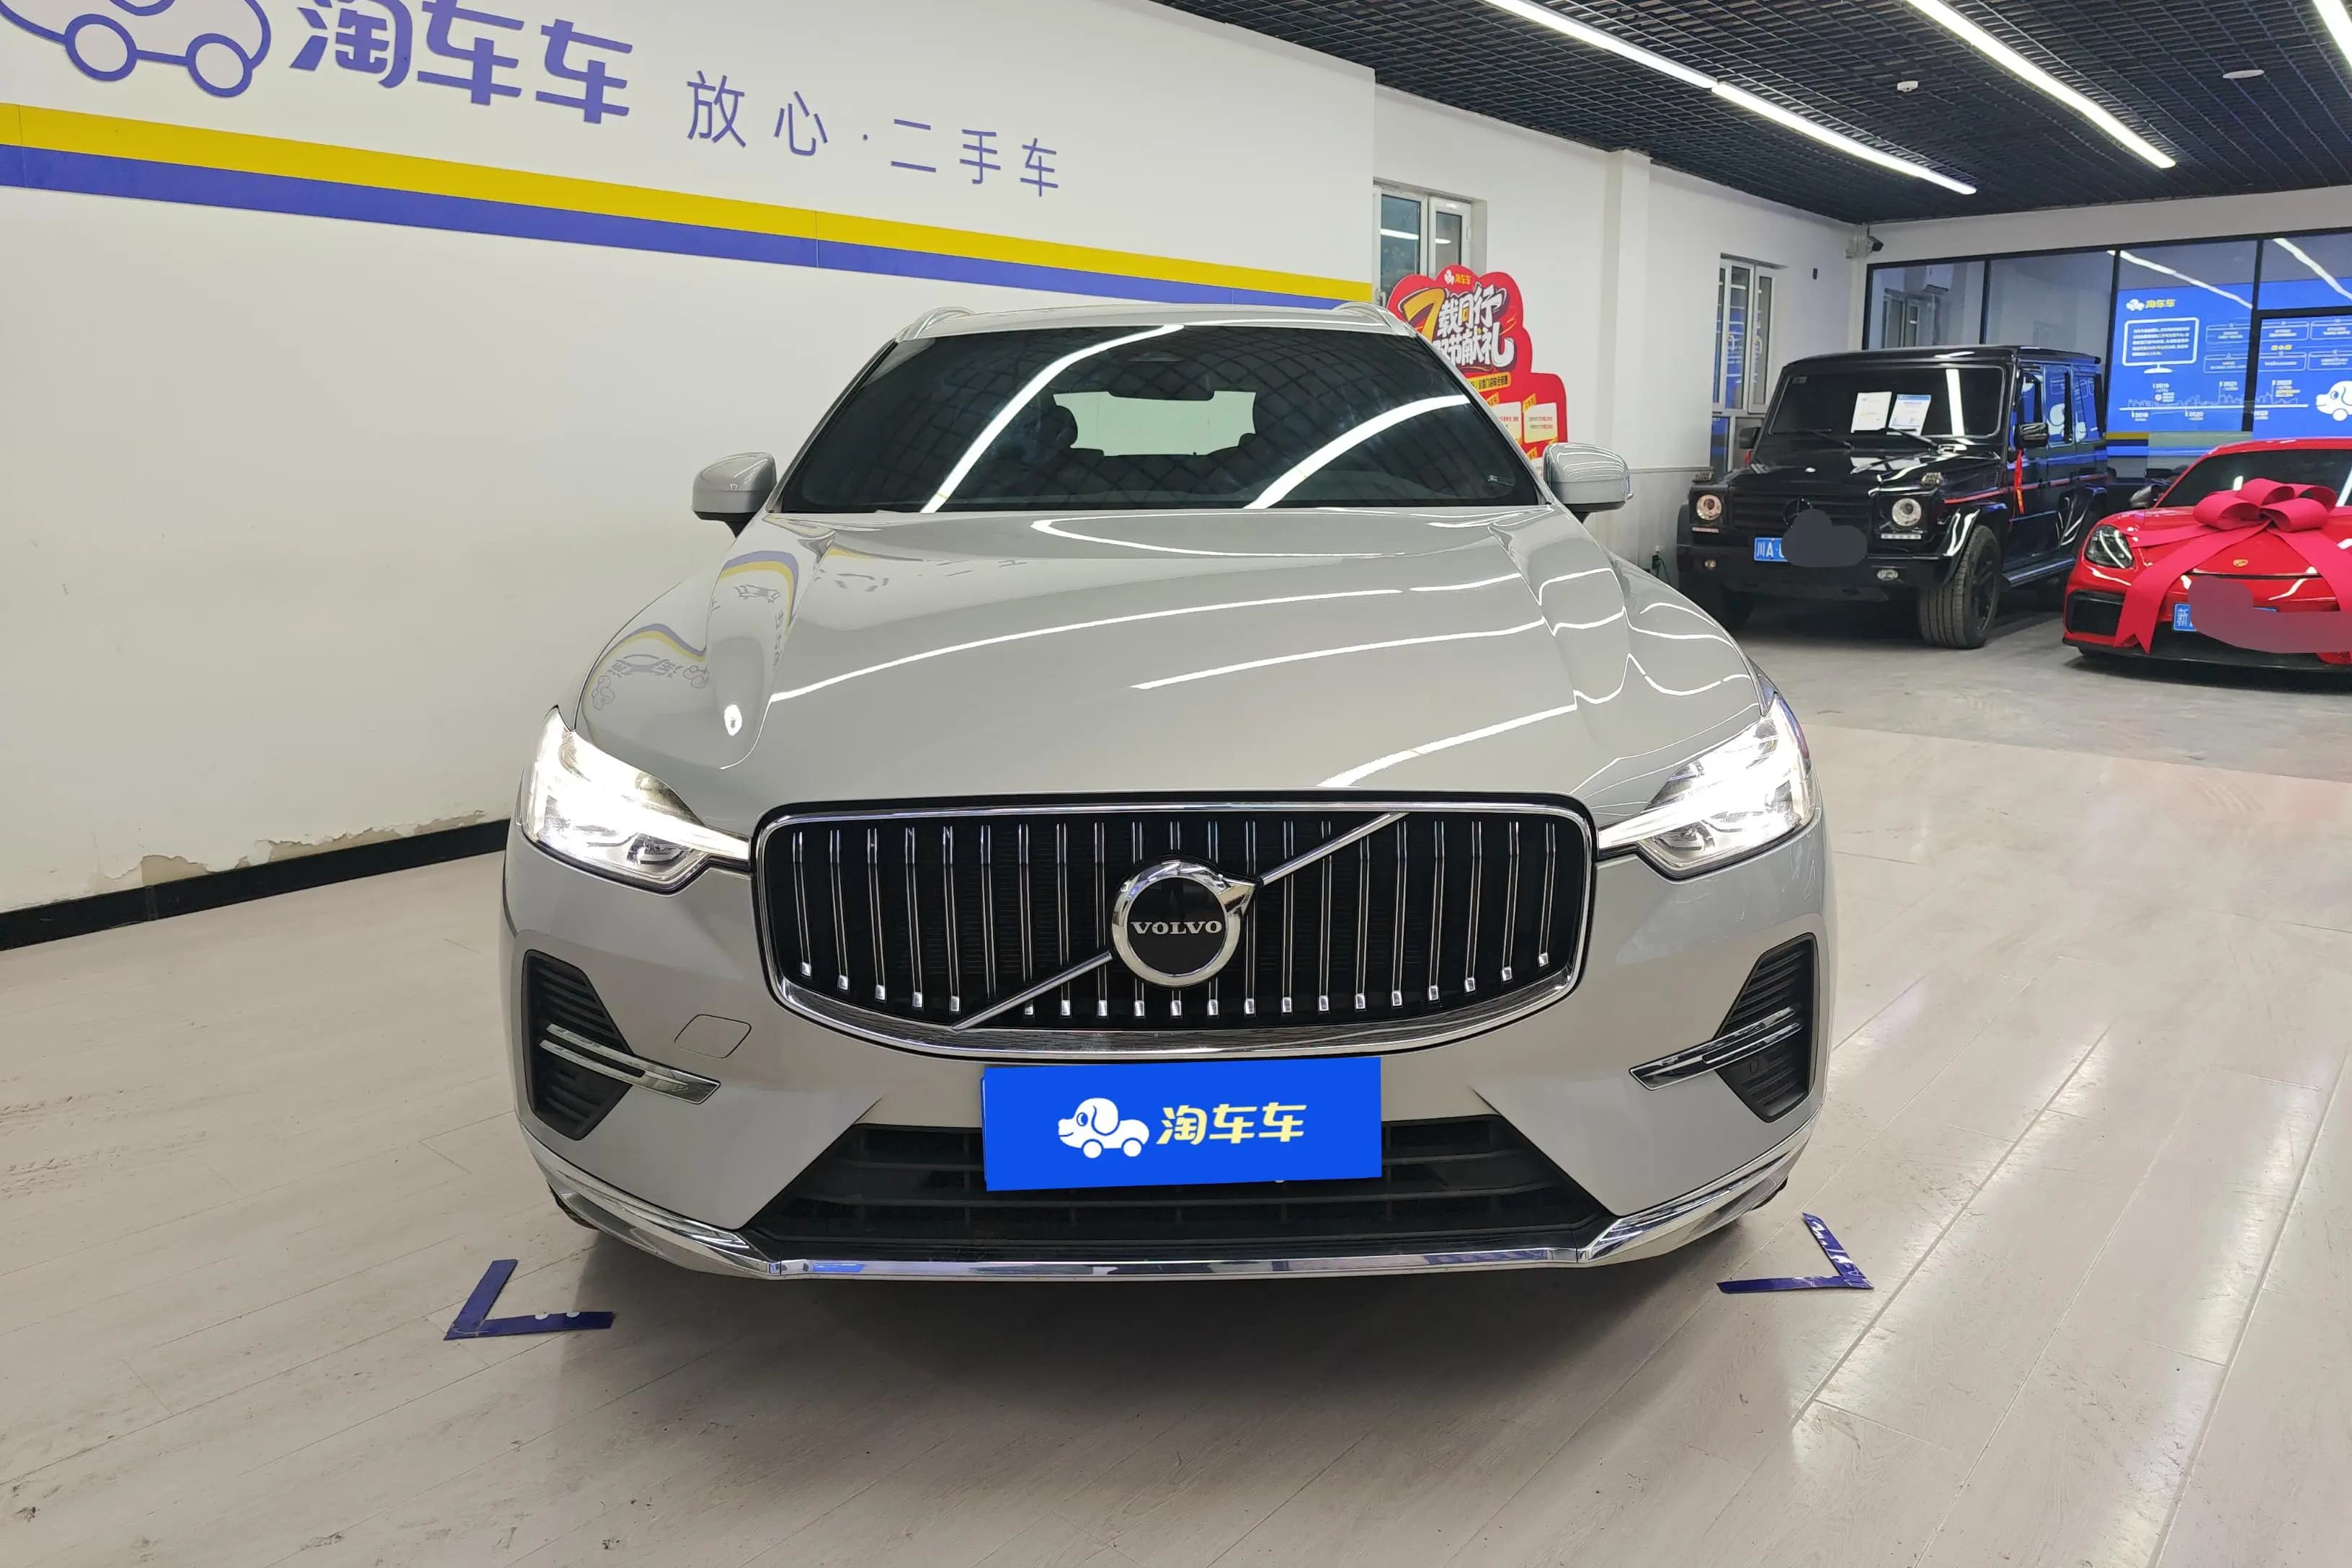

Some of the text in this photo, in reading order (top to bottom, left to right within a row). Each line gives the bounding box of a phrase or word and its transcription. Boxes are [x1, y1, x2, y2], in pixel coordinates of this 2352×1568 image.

[289, 0, 633, 124] 淘车车
[1130, 920, 1222, 935] VOLVO
